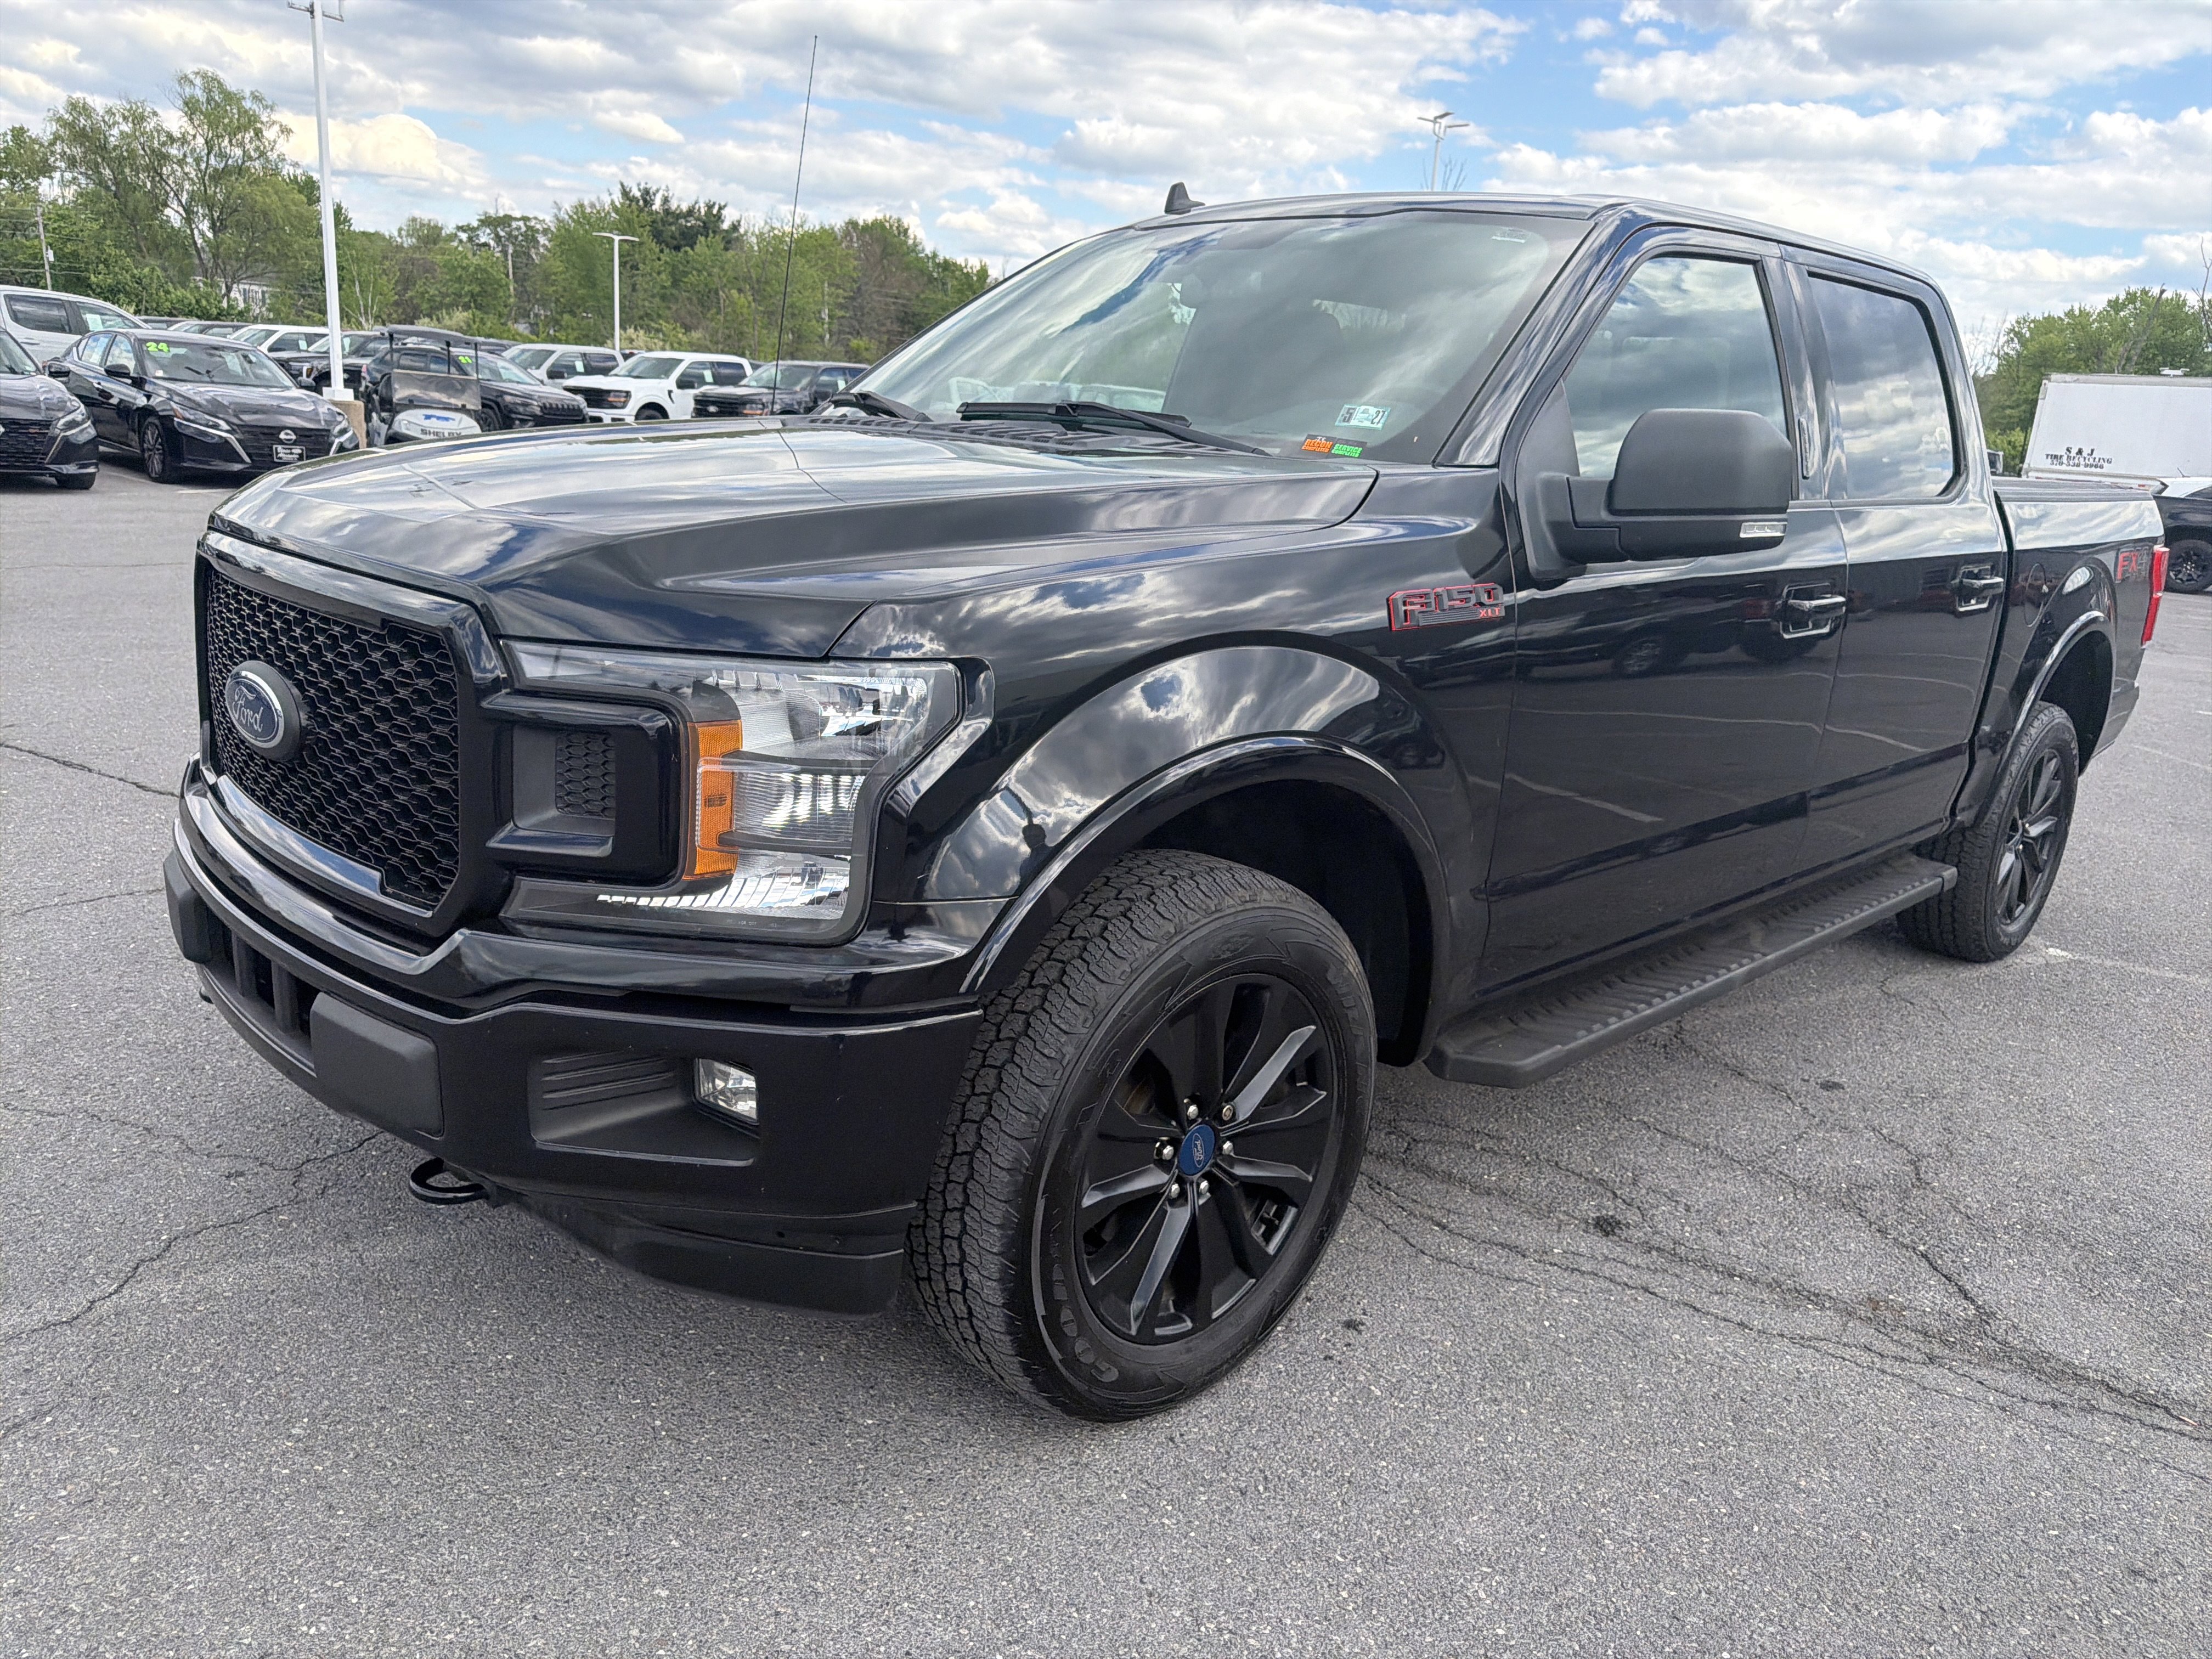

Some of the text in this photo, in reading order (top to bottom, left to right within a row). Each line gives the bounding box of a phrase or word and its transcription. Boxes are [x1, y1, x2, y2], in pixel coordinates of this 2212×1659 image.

[1370, 410, 1386, 425] 27
[1304, 439, 1333, 448] RECON
[1334, 443, 1363, 453] SERVICE
[1331, 449, 1360, 458] COMPLETED
[2065, 447, 2095, 456] S & J
[2066, 455, 2112, 464] RECYCLING
[2116, 548, 2149, 582] FX4
[1480, 607, 1500, 618] XLT
[232, 685, 264, 732] Ford
[1194, 1139, 1204, 1160] Ford
